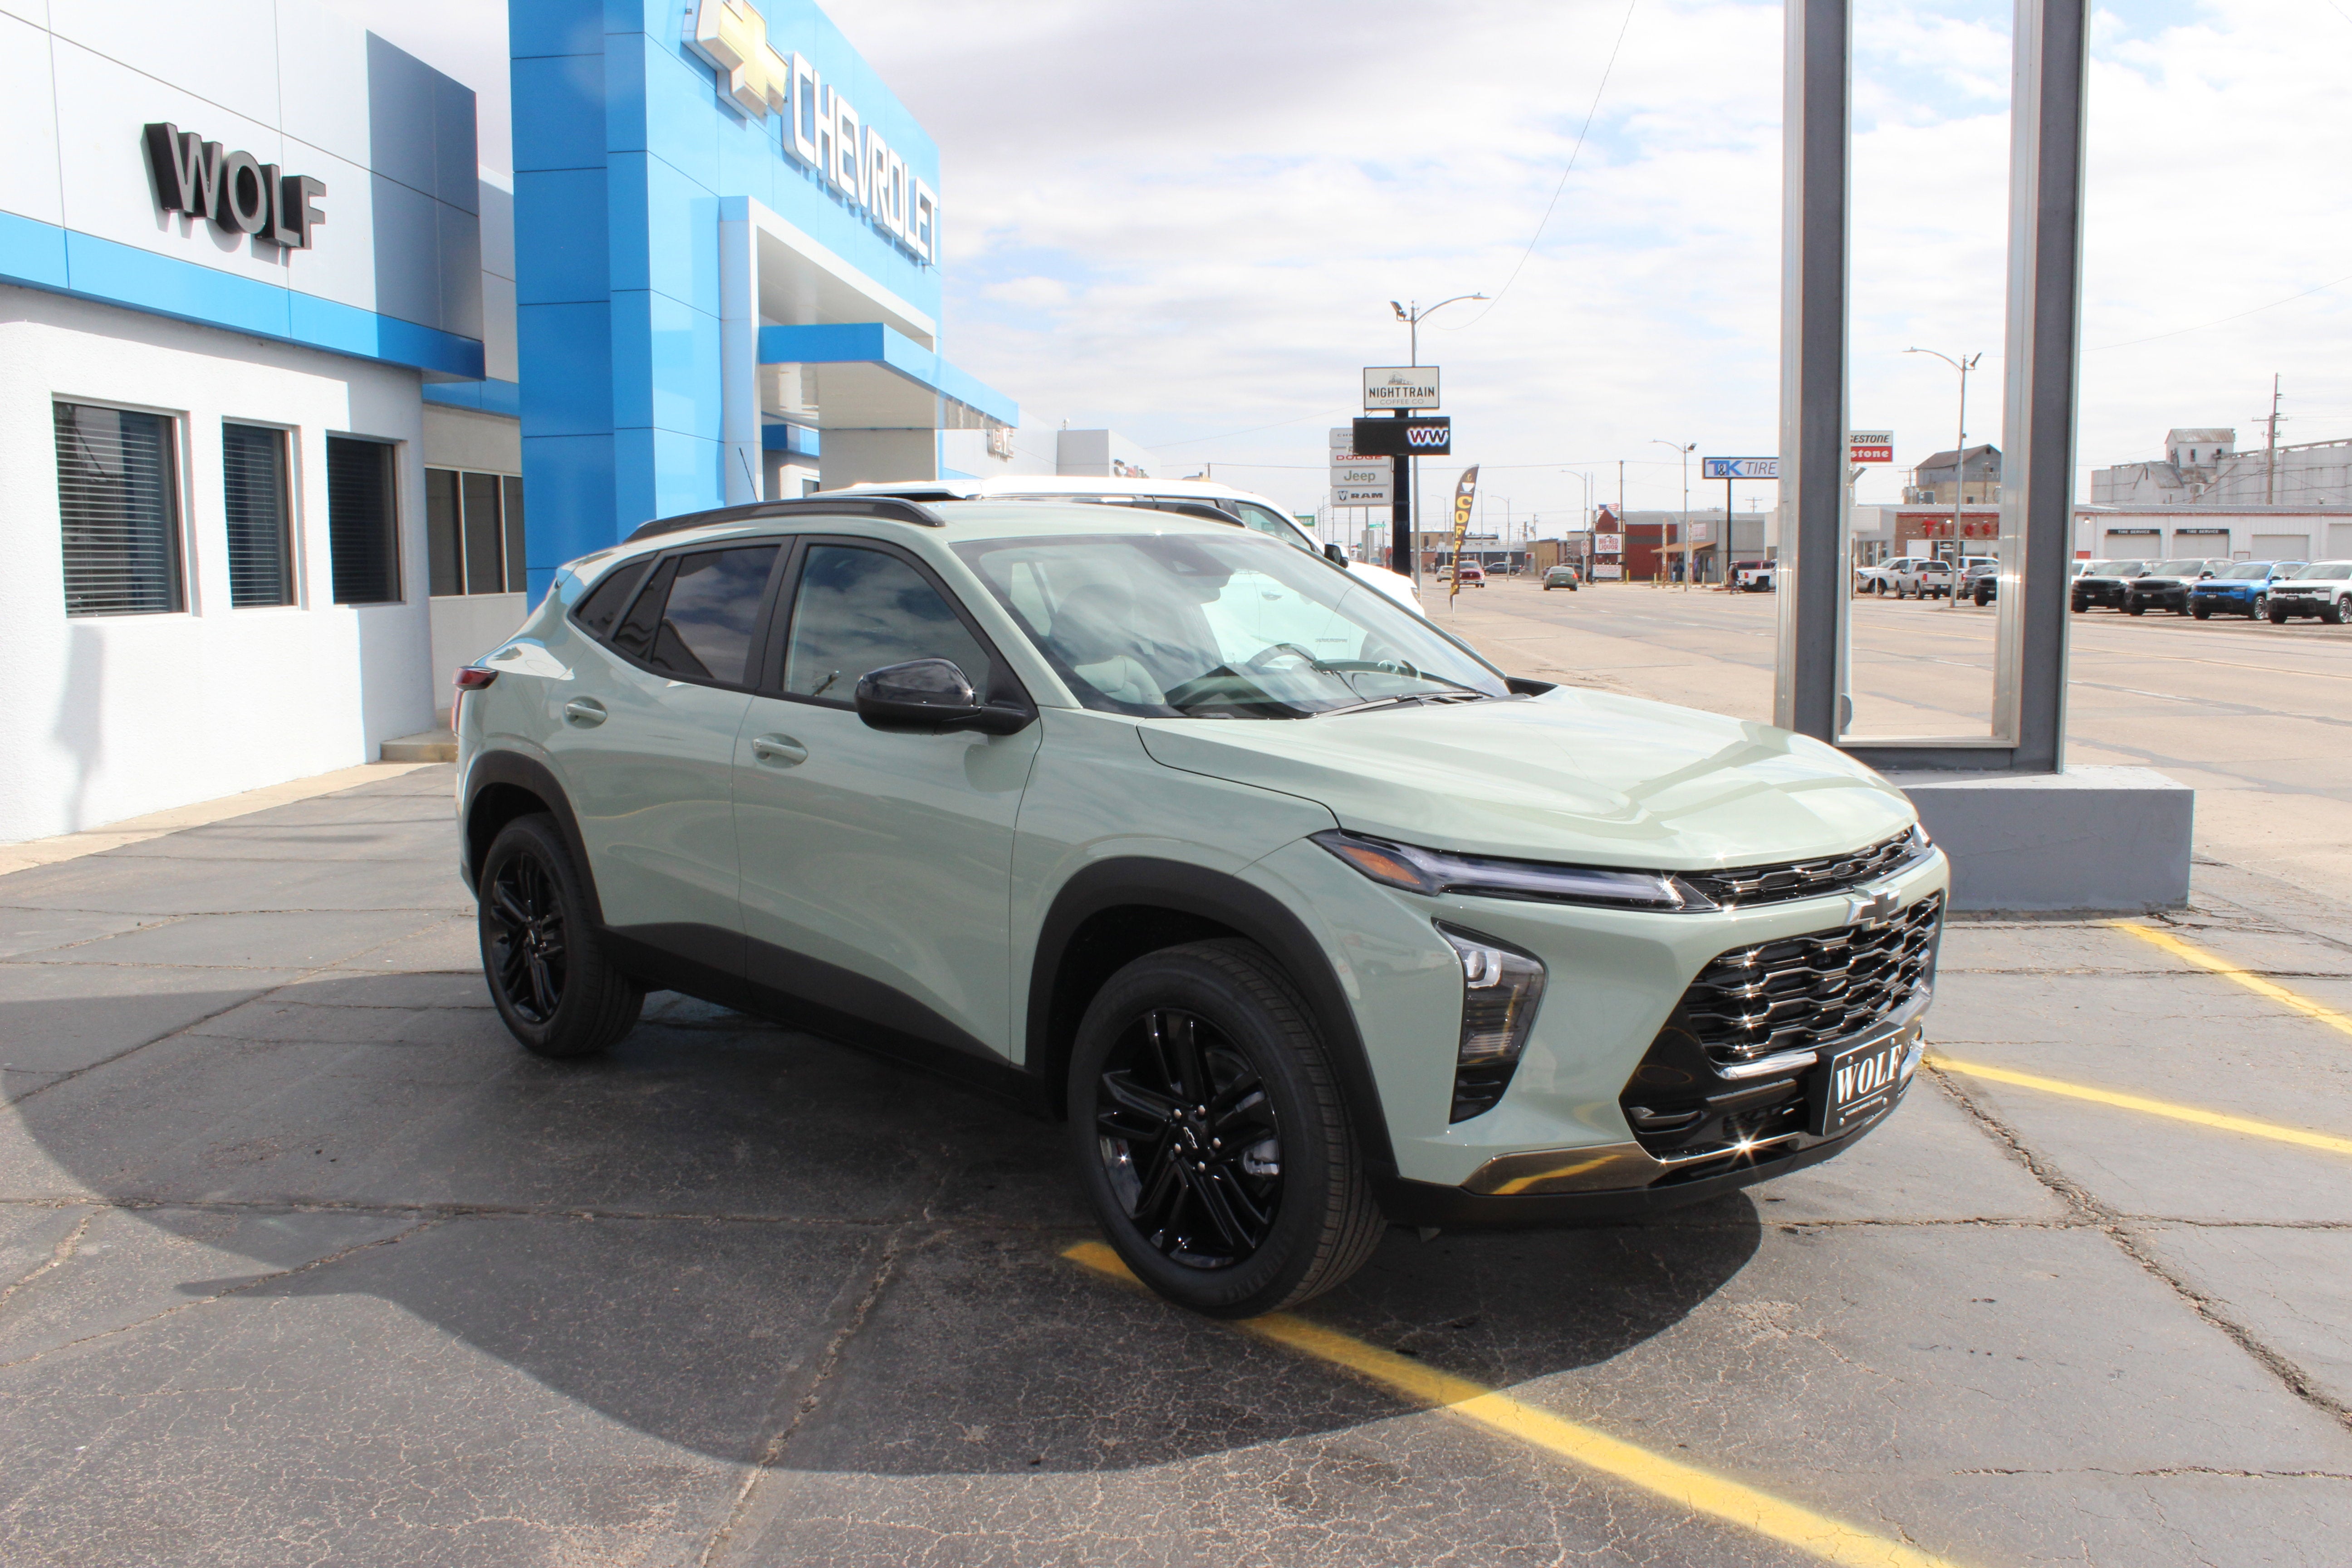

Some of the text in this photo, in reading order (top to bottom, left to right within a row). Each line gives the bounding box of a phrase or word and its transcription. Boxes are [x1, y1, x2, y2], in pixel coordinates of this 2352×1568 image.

[784, 51, 939, 267] CHEVROLET
[143, 122, 327, 250] WOLF
[1369, 387, 1435, 397] NIGHT TRAIN
[1409, 430, 1448, 443] WW
[1851, 449, 1889, 458] stone
[1745, 461, 1777, 475] TIRE
[1344, 470, 1376, 483] Jeep
[1837, 1044, 1902, 1104] WOLF
